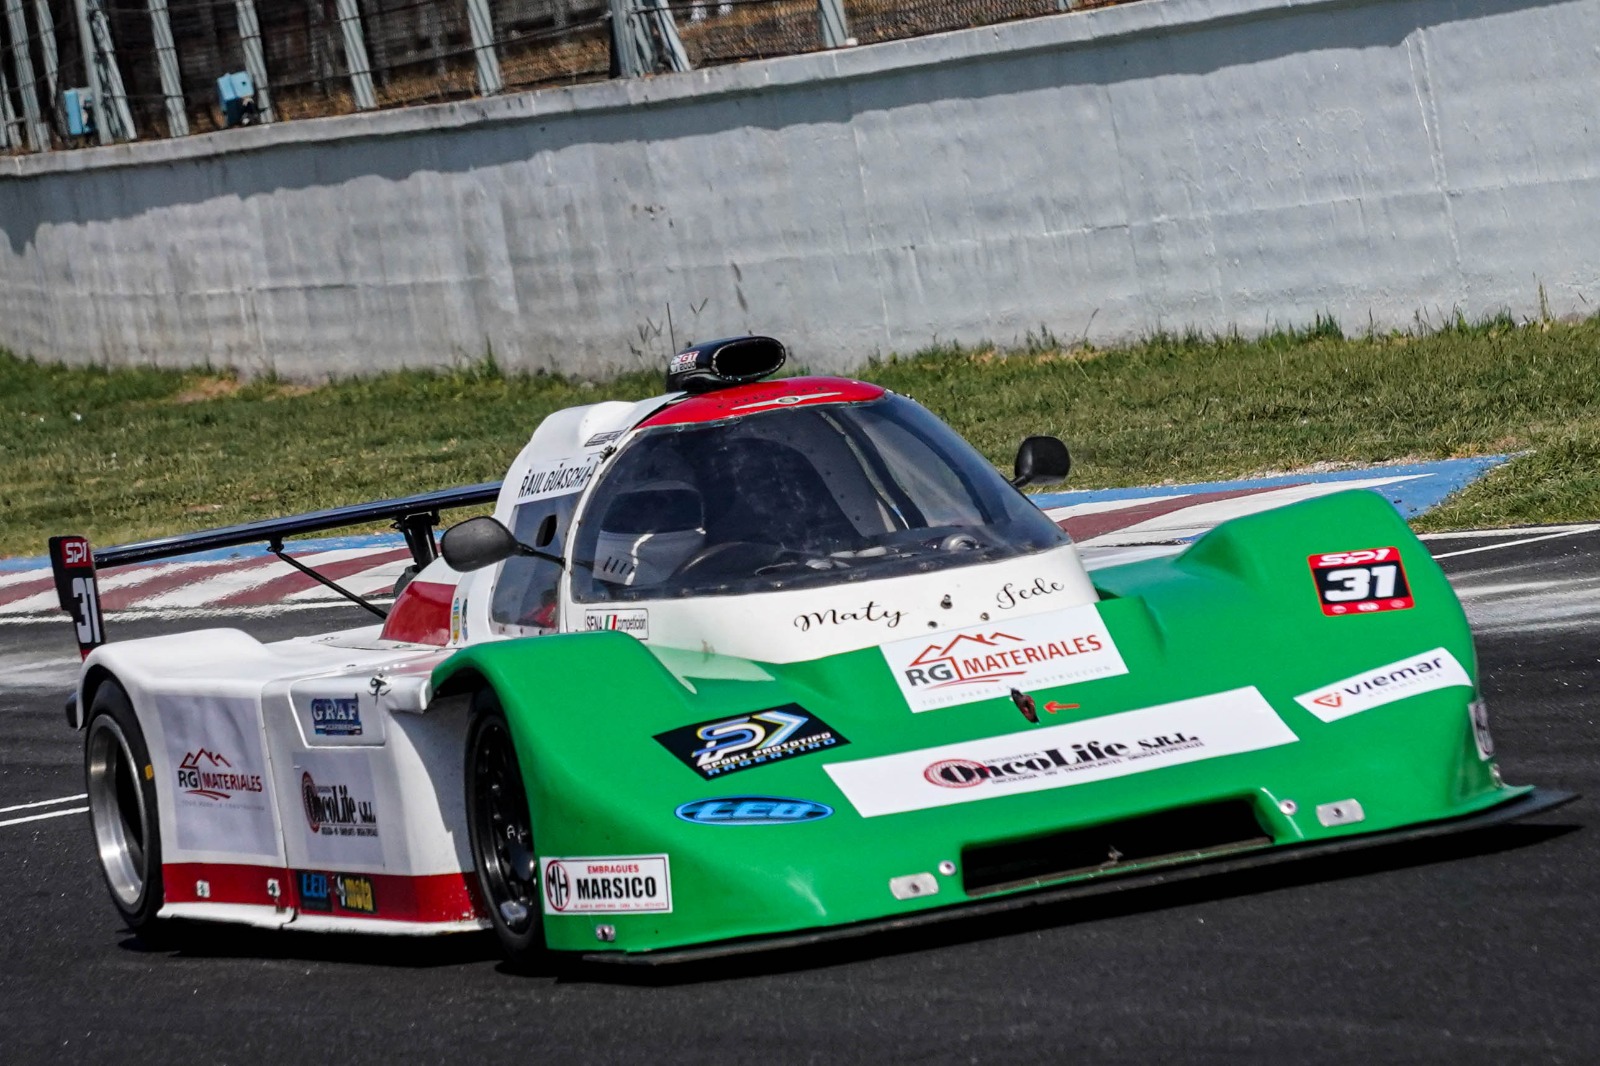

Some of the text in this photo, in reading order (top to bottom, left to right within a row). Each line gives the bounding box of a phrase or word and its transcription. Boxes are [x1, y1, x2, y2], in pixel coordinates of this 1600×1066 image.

[518, 472, 546, 498] RAUL
[1325, 565, 1397, 602] 31
[72, 577, 101, 643] 31
[793, 601, 909, 632] Maty
[905, 634, 1103, 686] RG MATERIALES
[312, 702, 357, 721] GRAF
[701, 731, 832, 771] SPORT PROTOTIPO
[707, 738, 837, 776] ARGENTINO
[940, 740, 1131, 783] OncoLife
[177, 770, 262, 792] RG MATERIALES
[587, 864, 640, 874] EMBRAGUES
[576, 876, 657, 900] MARSICO
